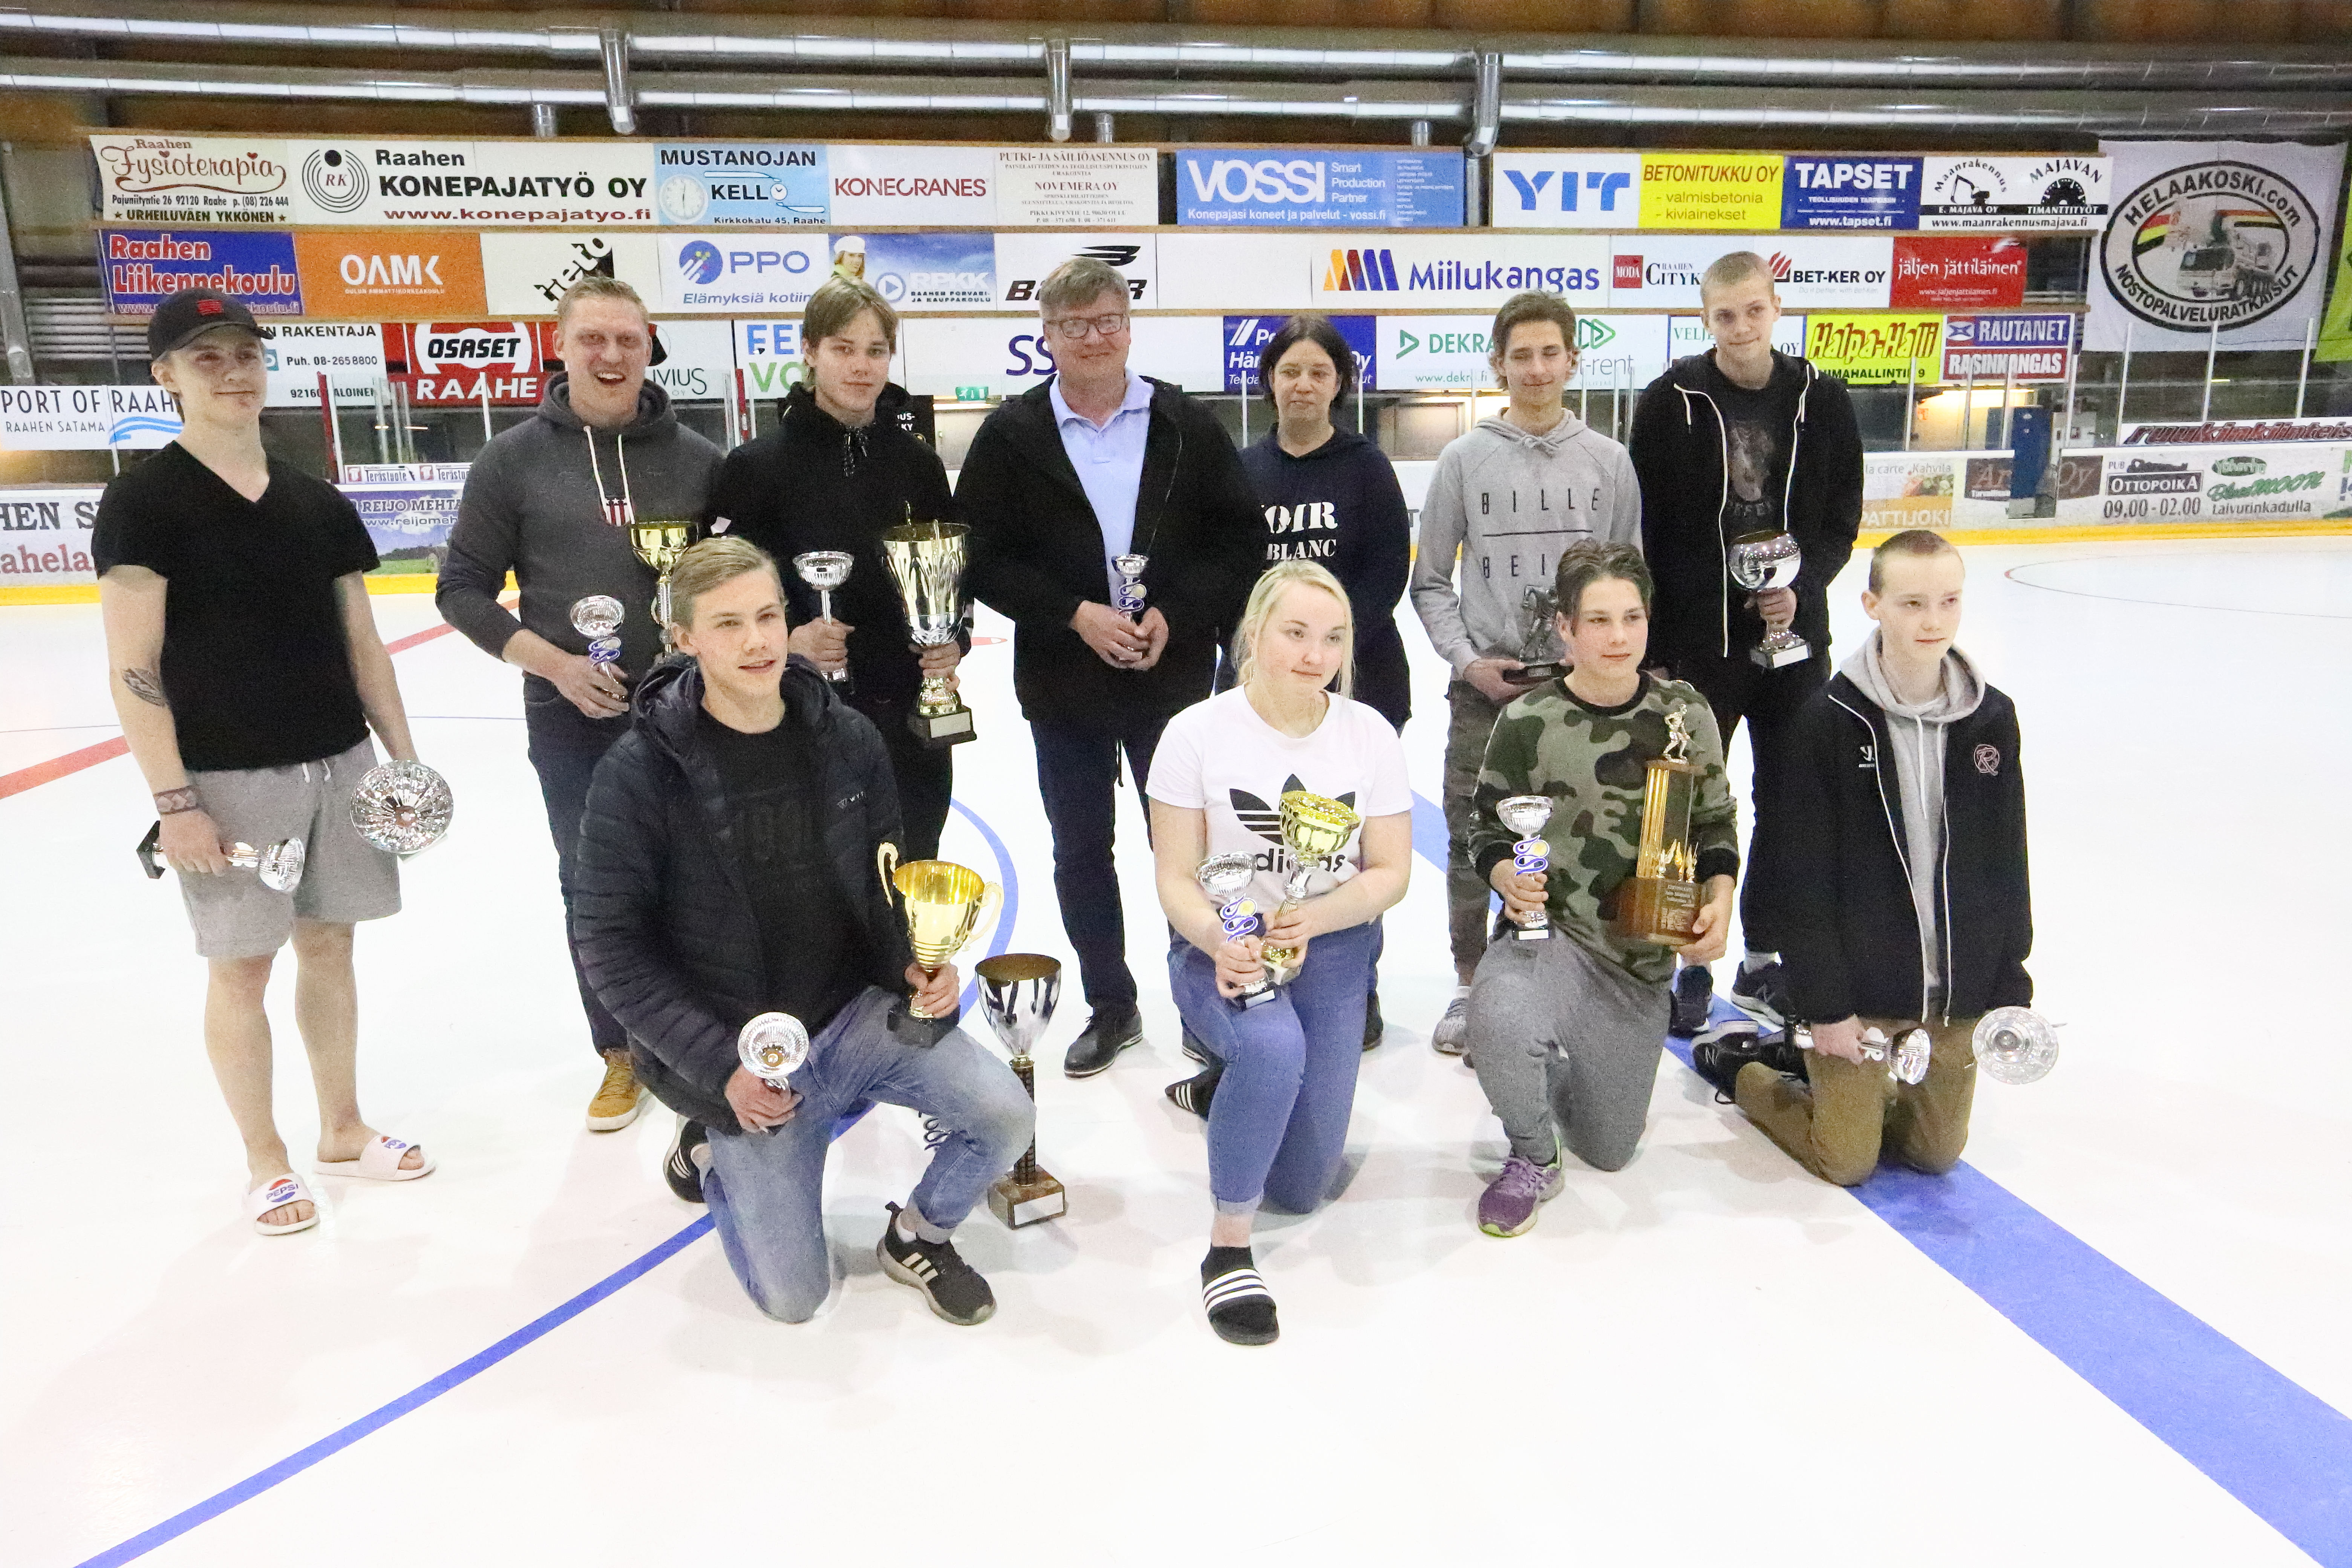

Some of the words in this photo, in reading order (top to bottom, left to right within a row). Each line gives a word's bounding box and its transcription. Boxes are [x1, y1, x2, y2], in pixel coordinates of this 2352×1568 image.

[135, 139, 192, 149] Raahen
[376, 149, 465, 166] Raahen
[661, 150, 816, 167] MUSTANOJAN
[1000, 152, 1036, 161] PUTKI-
[1039, 152, 1050, 161] JA
[1138, 153, 1152, 161] OY
[101, 145, 286, 185] Fysioterapia
[1332, 162, 1361, 173] Smart
[2029, 159, 2102, 184] MAJAVAN
[1187, 159, 1326, 203] VOSSI
[1643, 165, 1753, 182] BETONITUKKU
[1756, 166, 1779, 183] OY
[1794, 162, 1913, 189] TAPSET
[1934, 159, 2007, 193] Maanrakennus
[379, 172, 594, 198] KONEPAJATYÖ
[608, 178, 647, 198] OY
[835, 178, 986, 196] KONECRANES
[1035, 182, 1099, 191] NOVEMERA
[1103, 182, 1119, 191] OY
[1332, 178, 1385, 188] Production
[1503, 170, 1631, 211] YIT
[163, 196, 172, 205] 26
[176, 196, 199, 205] 92120
[204, 196, 226, 206] Raahe
[242, 196, 258, 207] (08)
[260, 196, 273, 206] 226
[1332, 193, 1367, 203] Partner
[1666, 191, 1763, 204] valmisbetonia
[127, 208, 210, 222] URHEILUVÄEN
[217, 209, 274, 223] YKKÖNEN
[383, 208, 651, 222] www.konepajatyo.fi
[1188, 209, 1246, 221] Konepajasi
[1249, 210, 1285, 220] koneet
[1288, 210, 1297, 221] ja
[1300, 210, 1340, 221] palvelut
[1350, 210, 1386, 220] vossi.fi
[1666, 208, 1746, 220] kiviainekset
[1949, 205, 1983, 214] MAJAVA
[1985, 205, 1998, 214] OY
[2027, 204, 2098, 214] TIMANTTITYÖT
[714, 216, 771, 225] Kirkkokatu
[775, 216, 790, 225] 45,
[793, 216, 826, 225] Raahe
[1809, 216, 1892, 228] www.tapset.fi
[1932, 217, 2087, 228] www.maanrakennusmajava.fi
[109, 234, 211, 260] Raahen
[730, 250, 810, 274] PPO
[1898, 257, 1939, 280] jäljen
[1943, 257, 2018, 280] jättiläinen
[341, 255, 443, 286] OAMK
[1409, 260, 1600, 293] Miilukangas
[1616, 266, 1640, 278] MODA
[1646, 263, 1701, 285] CITYK
[1793, 271, 1859, 283] BET-KER
[1865, 271, 1886, 283] OY
[113, 264, 296, 295] Liikennekoulu
[909, 272, 989, 290] RPKK
[683, 292, 764, 306] Elämyksiä
[283, 326, 376, 337] RAKENTAJA
[428, 338, 521, 358] OSASET
[1429, 333, 1496, 354] DEKRA
[1781, 343, 1799, 355] OY
[1810, 322, 1939, 364] Halpa-Halli
[287, 356, 310, 366] Puh.
[1416, 370, 1487, 382] www.dekr.fi
[1918, 369, 1925, 377] 9
[416, 377, 537, 400] RAAHE
[1, 390, 61, 413] PORT
[73, 390, 101, 413] OF
[112, 390, 175, 413] RAAH
[6, 421, 53, 433] RAAHEN
[58, 421, 105, 432] SATAMA
[2109, 461, 2124, 470] PUB
[362, 500, 407, 513] REIJO
[1482, 488, 1600, 514] BILLE
[2104, 499, 2148, 518] 09.00
[2160, 497, 2200, 516] 02.00
[1261, 501, 1338, 534] OIR
[1266, 539, 1337, 560] BLANC
[1482, 554, 1545, 578] BEI
[266, 1184, 299, 1200] PEPSI
